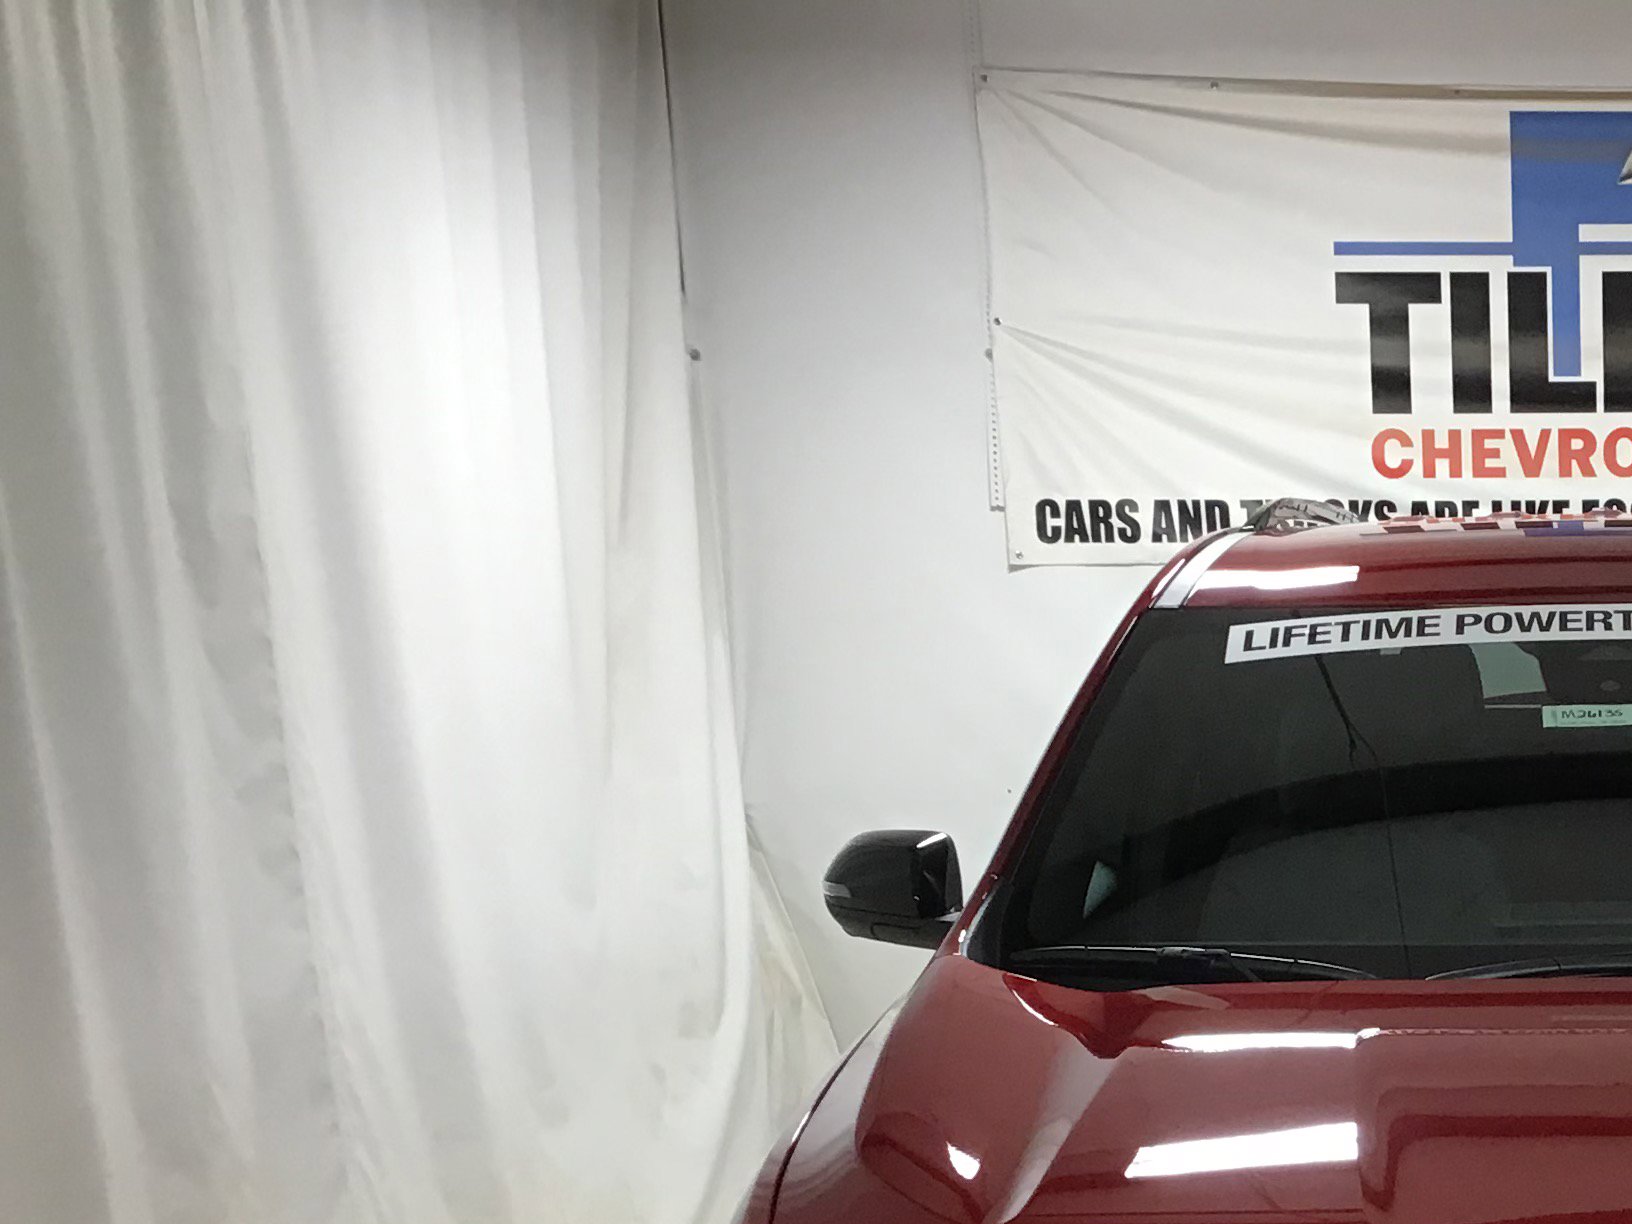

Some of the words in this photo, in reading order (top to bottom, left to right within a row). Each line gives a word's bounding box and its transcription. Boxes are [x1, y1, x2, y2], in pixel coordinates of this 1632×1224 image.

[1035, 499, 1141, 544] CARS
[1150, 499, 1232, 544] AND
[1242, 615, 1441, 652] LIFETIME
